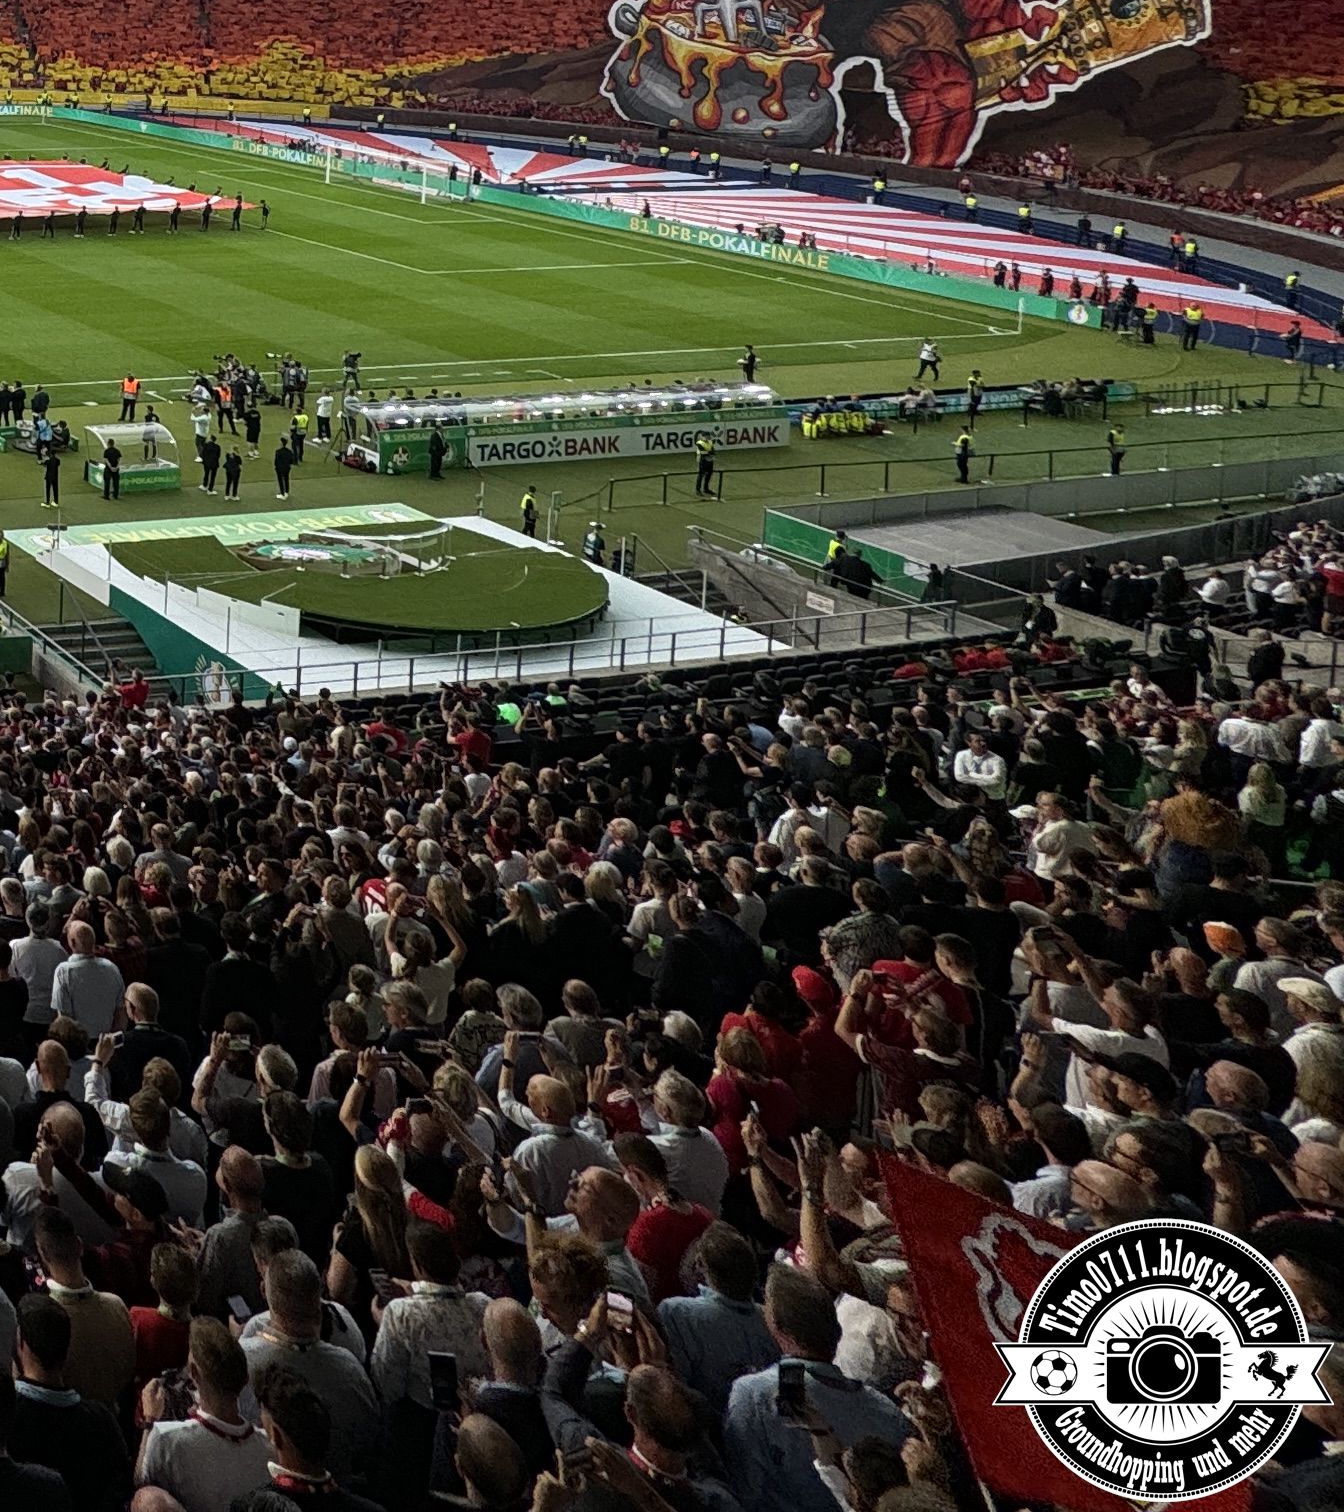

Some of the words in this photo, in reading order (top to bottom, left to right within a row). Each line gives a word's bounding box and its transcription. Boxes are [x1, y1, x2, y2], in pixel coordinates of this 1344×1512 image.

[629, 217, 653, 234] 81.
[658, 223, 830, 270] DFB-POKALFINALE
[477, 440, 545, 462] TARGO
[564, 435, 620, 456] BANK
[726, 425, 780, 446] BANK
